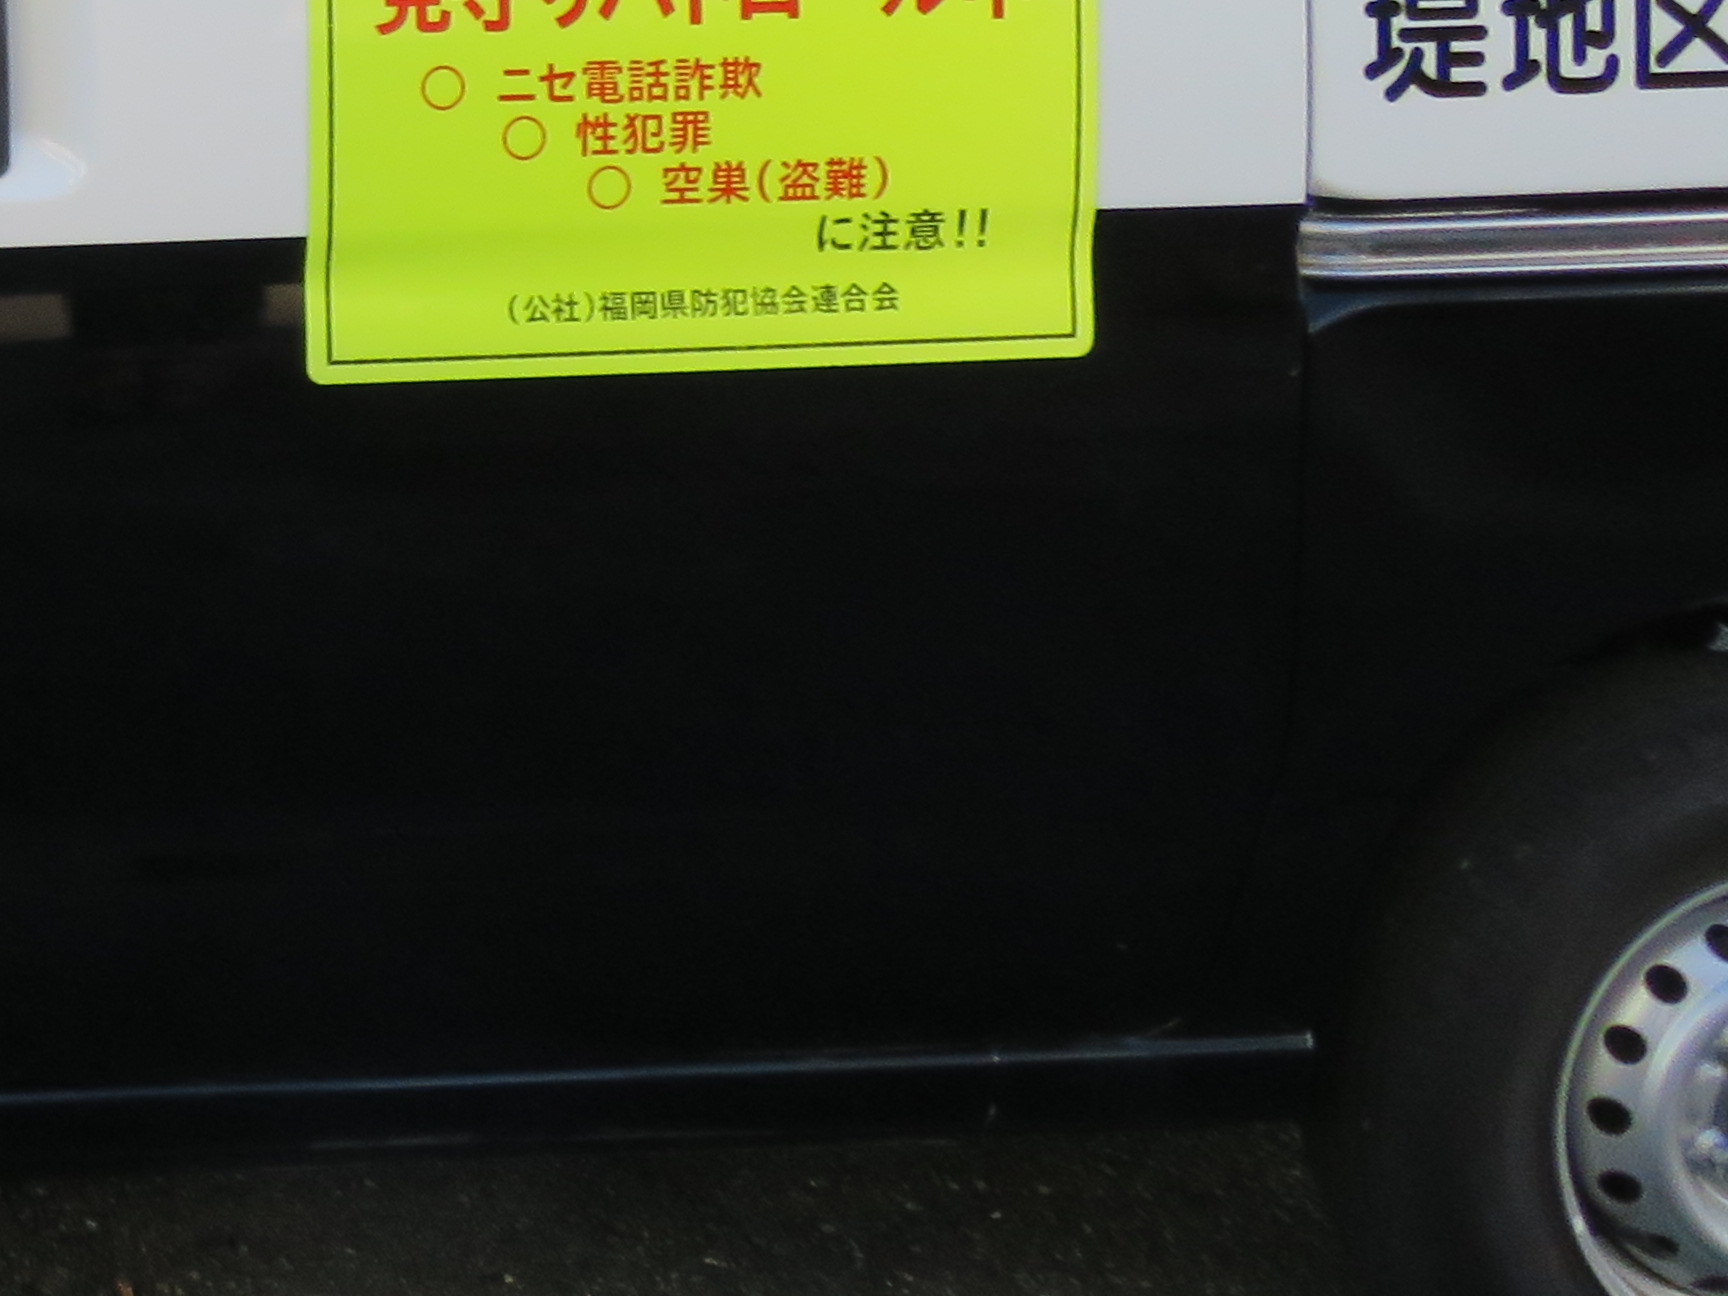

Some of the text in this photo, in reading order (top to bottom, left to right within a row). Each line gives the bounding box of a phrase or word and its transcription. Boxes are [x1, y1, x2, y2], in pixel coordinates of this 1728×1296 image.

[497, 56, 763, 105] ニセ電話詐欺
[575, 110, 712, 157] 性犯罪
[661, 156, 890, 205] 空巣(盗難)
[817, 208, 990, 252] に注意!!
[507, 281, 899, 325] (公社)福岡県防犯協会連合会
